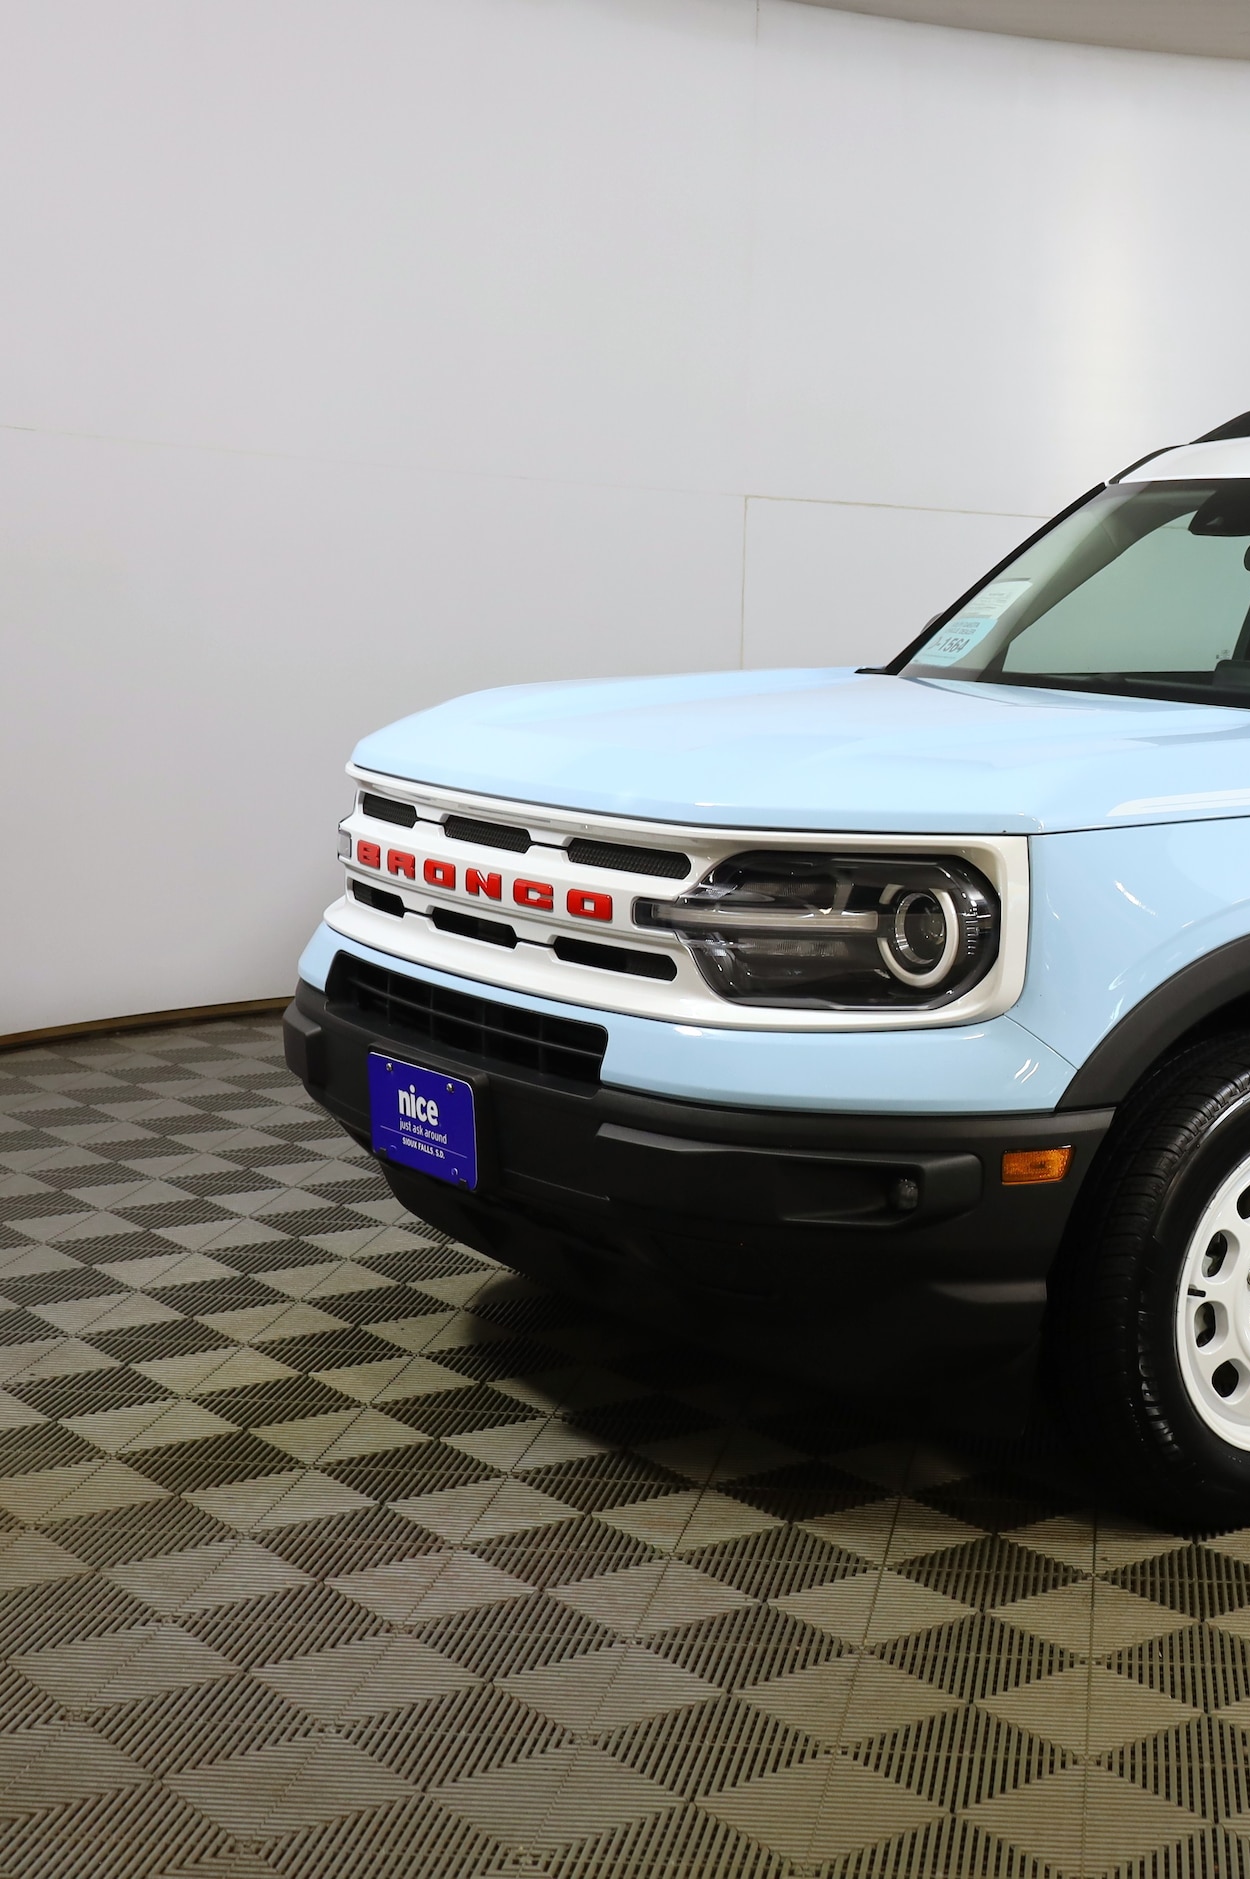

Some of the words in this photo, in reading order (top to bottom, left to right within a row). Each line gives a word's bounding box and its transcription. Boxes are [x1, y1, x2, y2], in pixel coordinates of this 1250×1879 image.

[357, 839, 613, 921] BRONCO
[398, 1084, 439, 1126] nice
[399, 1117, 412, 1132] just
[412, 1124, 424, 1136] ask
[424, 1129, 448, 1145] around
[402, 1136, 418, 1150] SIOUX
[435, 1148, 446, 1159] S.D.
